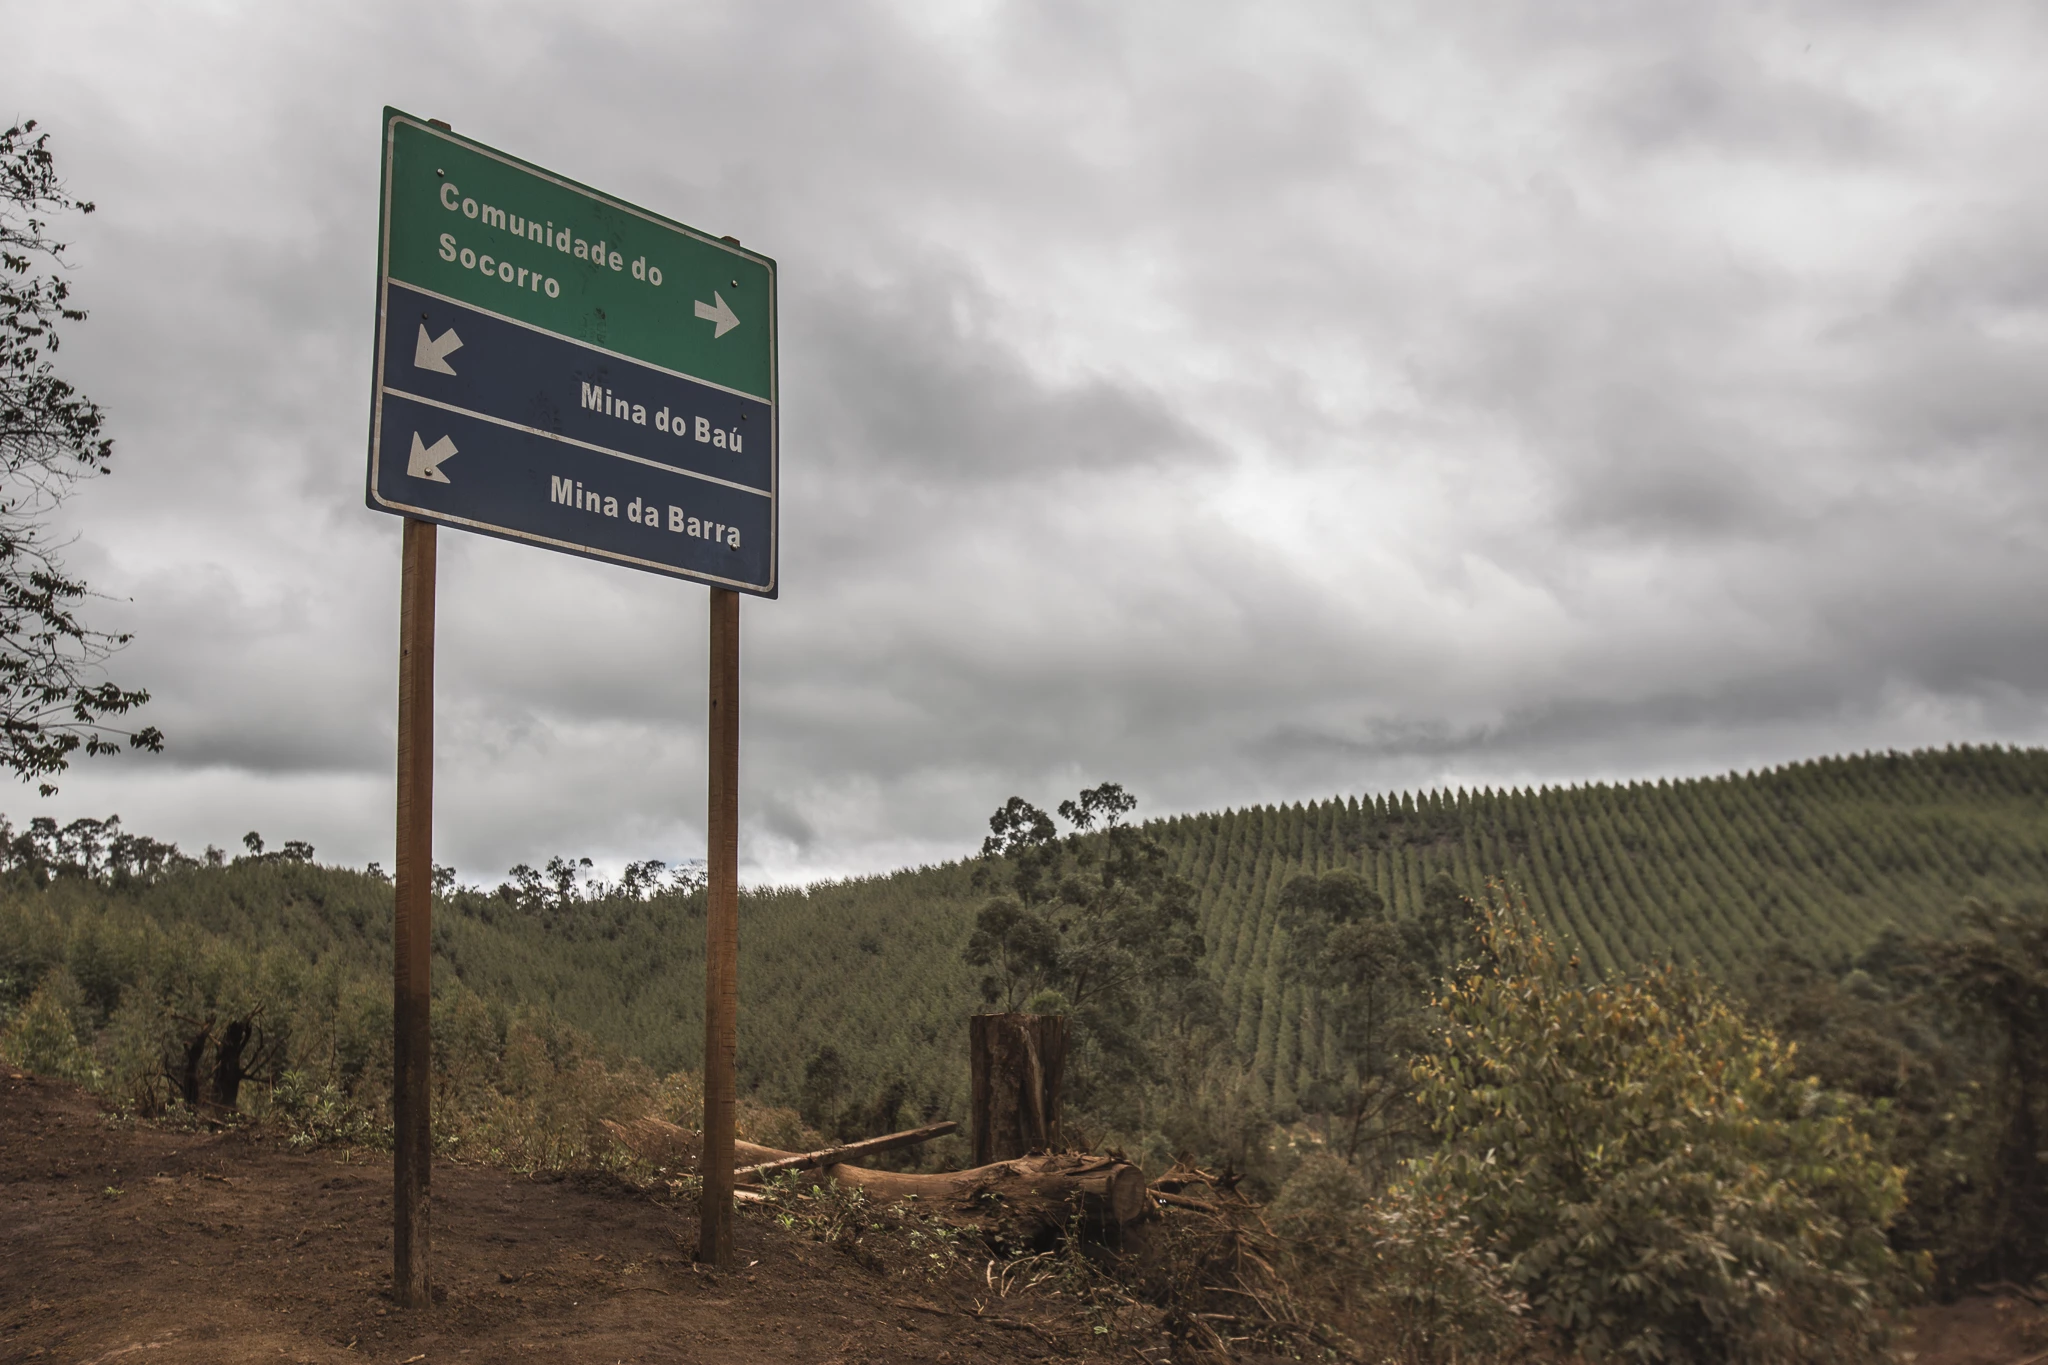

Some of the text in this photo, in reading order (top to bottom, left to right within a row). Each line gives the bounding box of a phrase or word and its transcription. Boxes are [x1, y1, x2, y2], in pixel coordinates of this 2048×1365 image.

[438, 232, 561, 300] Socorro
[439, 182, 664, 288] Comunidade do
[579, 381, 744, 454] Mina do Baú
[549, 474, 742, 549] Mina da Barra
